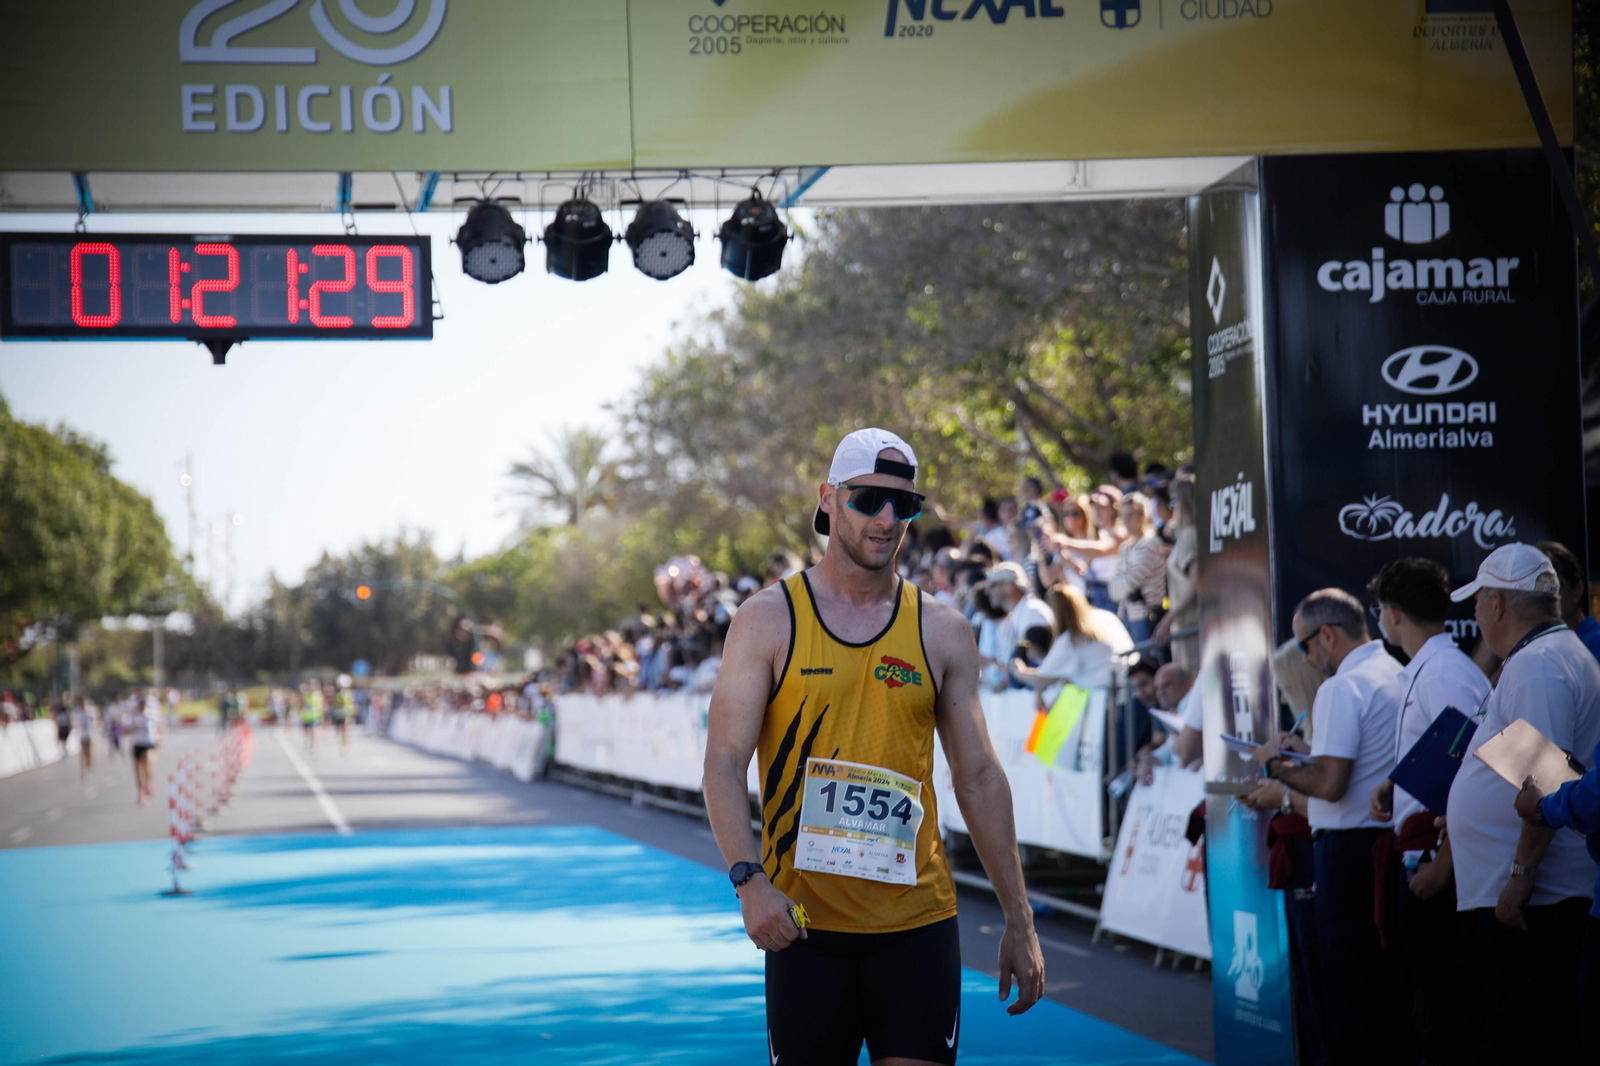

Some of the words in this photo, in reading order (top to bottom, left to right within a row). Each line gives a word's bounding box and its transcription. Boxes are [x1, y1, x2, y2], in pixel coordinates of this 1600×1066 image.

[1180, 0, 1273, 19] CIUDAD
[688, 12, 846, 34] COOPERACIÓN
[899, 25, 934, 37] 2020
[689, 36, 743, 55] 2005
[181, 73, 454, 134] EDICIÓN
[1317, 247, 1520, 303] cajamar
[1416, 290, 1458, 306] CAJA
[1463, 289, 1516, 304] RURAL
[1362, 401, 1497, 426] HYUNDAI
[1367, 427, 1494, 449] Almerialva
[873, 777, 890, 786] 2024
[819, 780, 913, 826] 1554
[838, 817, 886, 832] ALVAMAR
